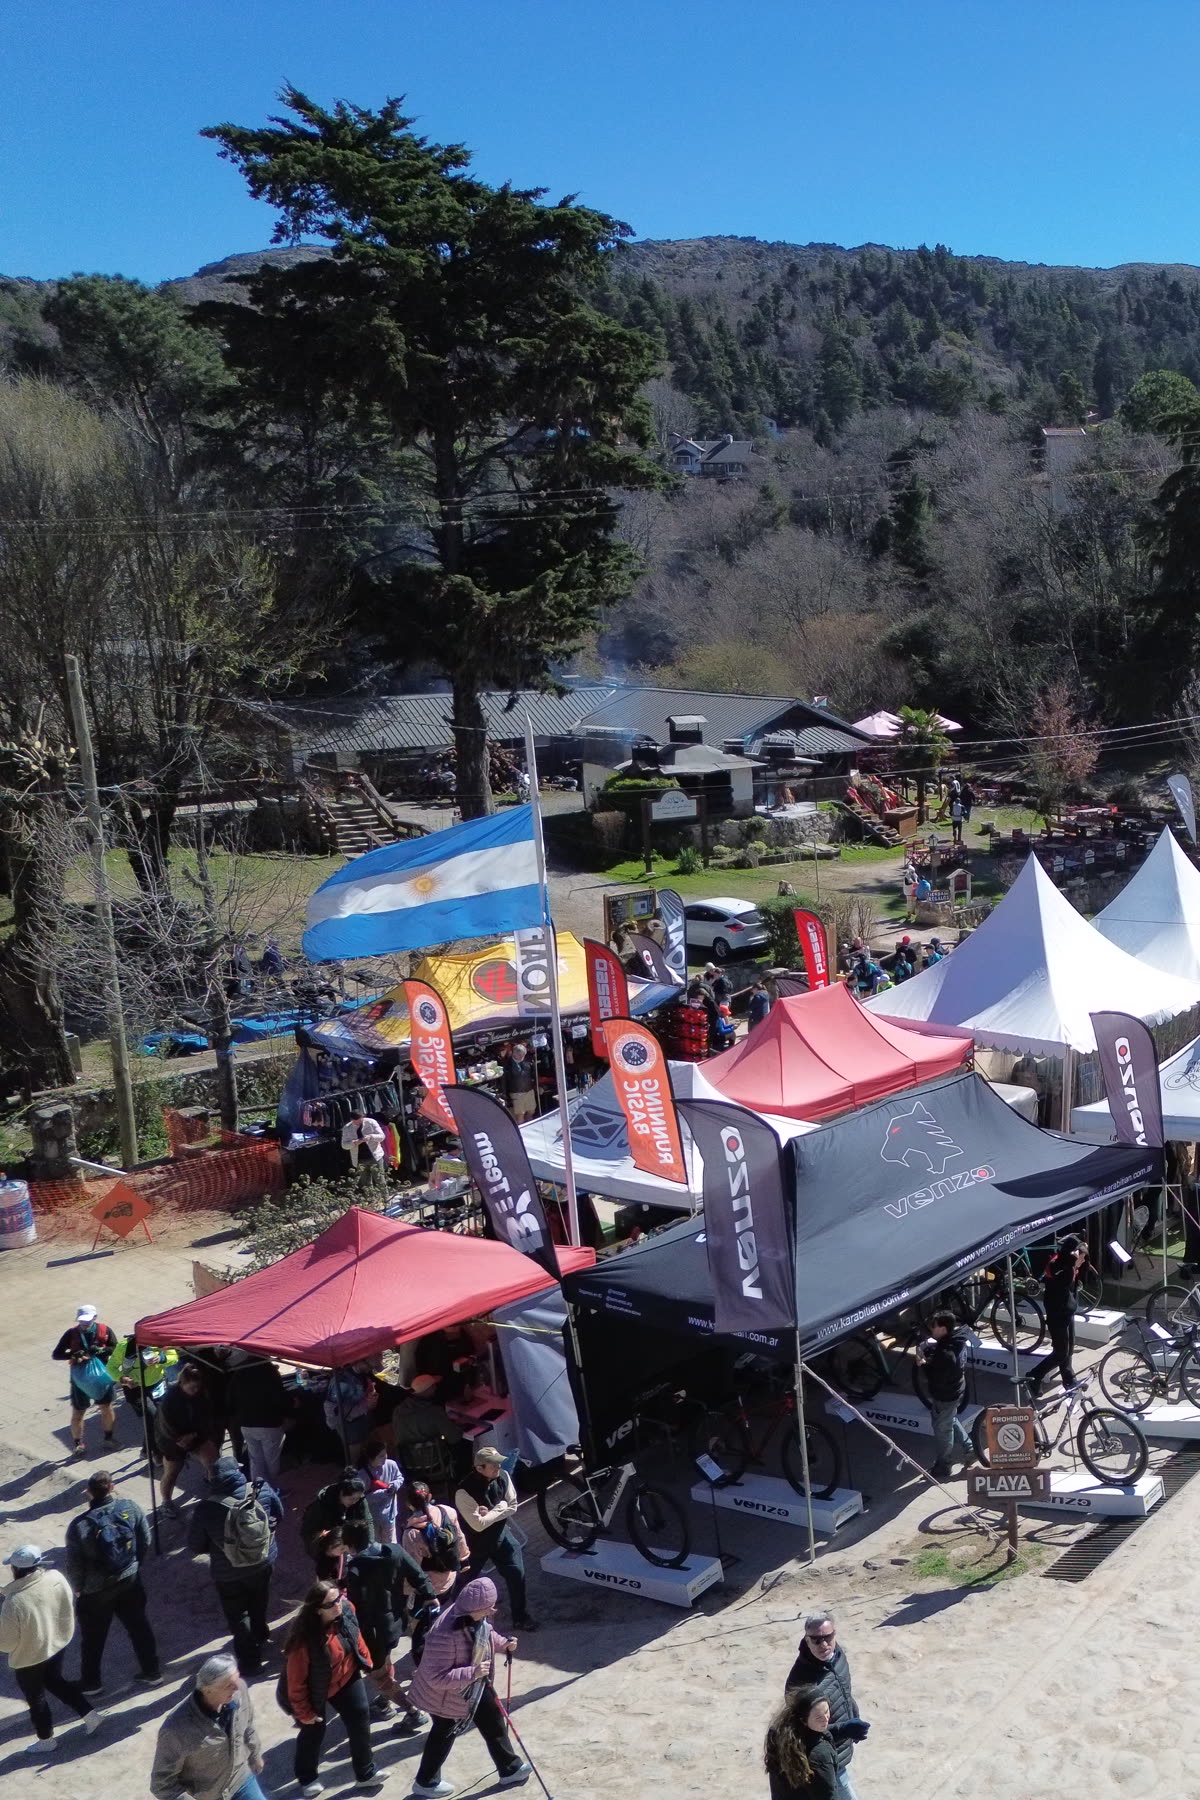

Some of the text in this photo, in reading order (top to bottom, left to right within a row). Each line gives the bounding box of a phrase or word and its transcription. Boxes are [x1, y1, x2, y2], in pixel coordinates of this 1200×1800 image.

[883, 1164, 997, 1219] venzo
[815, 1288, 911, 1340] www.karabitian.com.ar
[866, 1410, 920, 1428] venzo
[992, 1415, 1030, 1423] PROHIBIDO
[975, 1474, 1044, 1492] PLAYA 1
[732, 1497, 790, 1518] venzo
[583, 1569, 642, 1590] venzo
